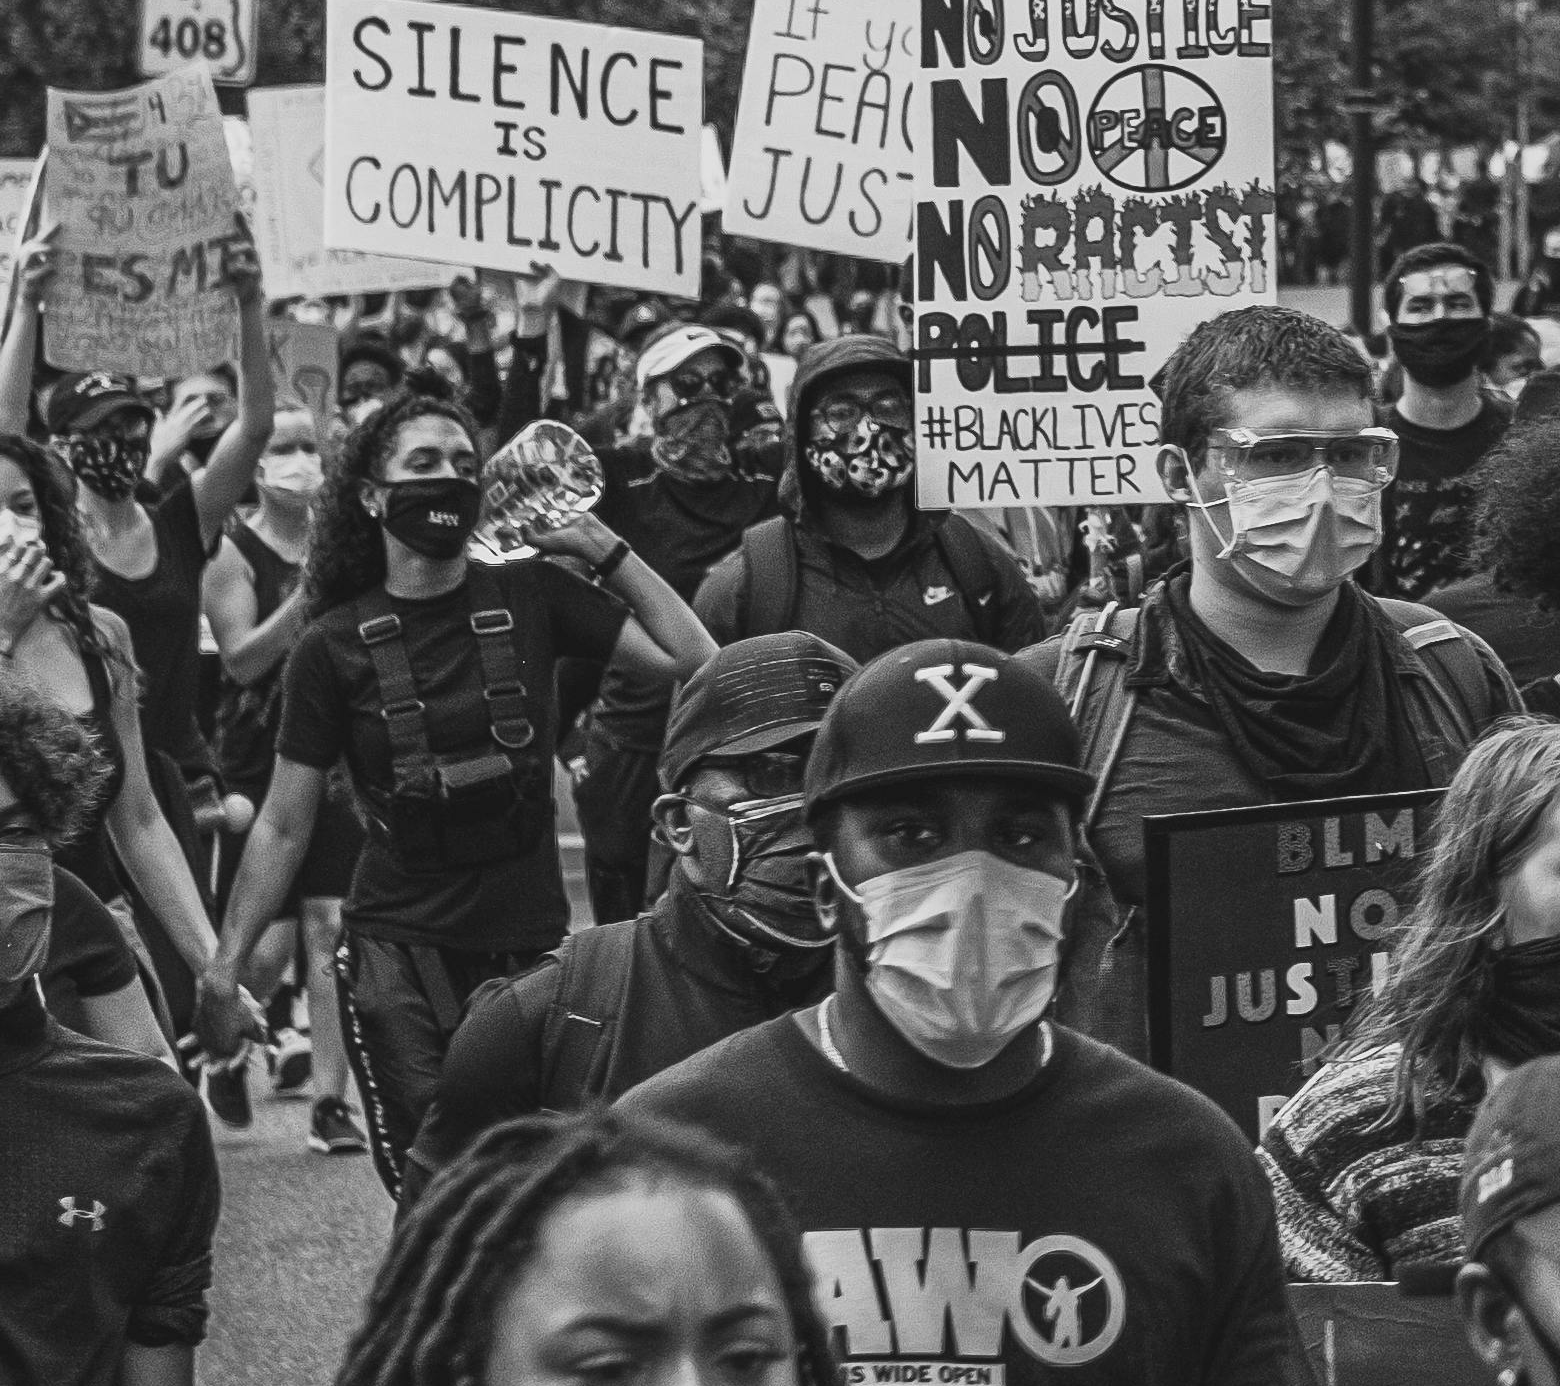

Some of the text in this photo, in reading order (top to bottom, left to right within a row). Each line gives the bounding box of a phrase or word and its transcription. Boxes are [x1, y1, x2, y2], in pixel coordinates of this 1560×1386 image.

[149, 17, 226, 59] 408
[352, 15, 685, 135] SILENCE
[494, 121, 547, 161] IS
[930, 68, 1224, 189] NO PEACE
[109, 140, 188, 198] TU
[346, 155, 698, 275] COMPLICITY
[916, 177, 1276, 303] NO RACIST
[82, 252, 155, 302] ES
[917, 306, 1146, 394] POLICE
[922, 401, 1162, 452] #BLACKLIVES
[948, 455, 1141, 503] MATTER
[914, 663, 1006, 744] X
[1274, 807, 1417, 878] BLM
[1292, 887, 1401, 949] NO
[1201, 951, 1392, 1029] JUSTI
[870, 1362, 933, 1386] WIDE
